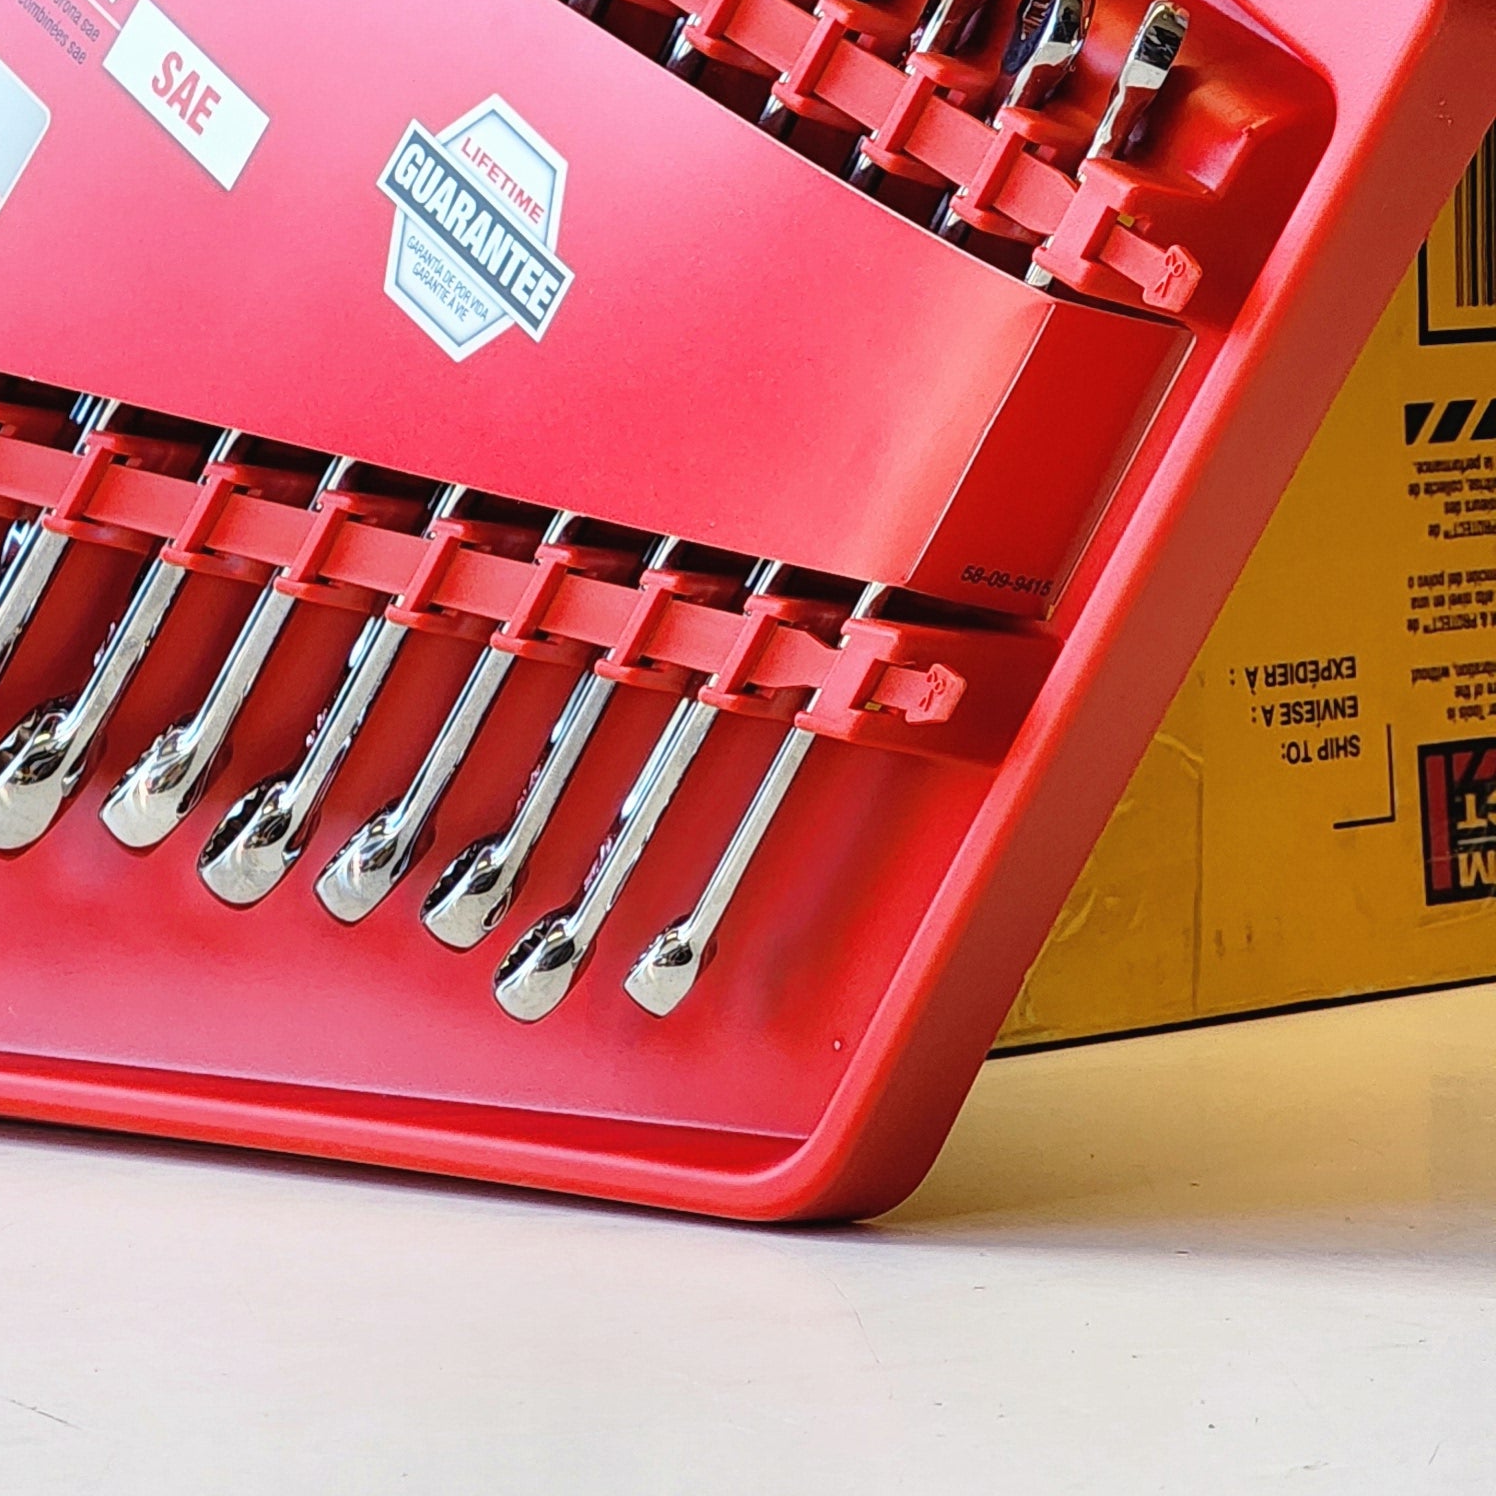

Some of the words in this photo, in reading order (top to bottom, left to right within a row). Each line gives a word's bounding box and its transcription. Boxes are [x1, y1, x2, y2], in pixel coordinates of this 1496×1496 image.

[80, 18, 101, 43] sae
[66, 41, 88, 65] sae
[150, 50, 222, 137] SAE
[460, 136, 546, 225] LIFETIME
[394, 142, 561, 321] GUARANTEE
[412, 261, 449, 302] GARANTIE
[441, 270, 456, 287] DE
[453, 281, 472, 303] POR
[469, 296, 490, 322] VIDA
[1263, 655, 1357, 689] EXPÉDIER
[1278, 694, 1359, 729] ENVÍESE
[1281, 739, 1314, 765] TO:
[1317, 733, 1362, 761] SHIP
